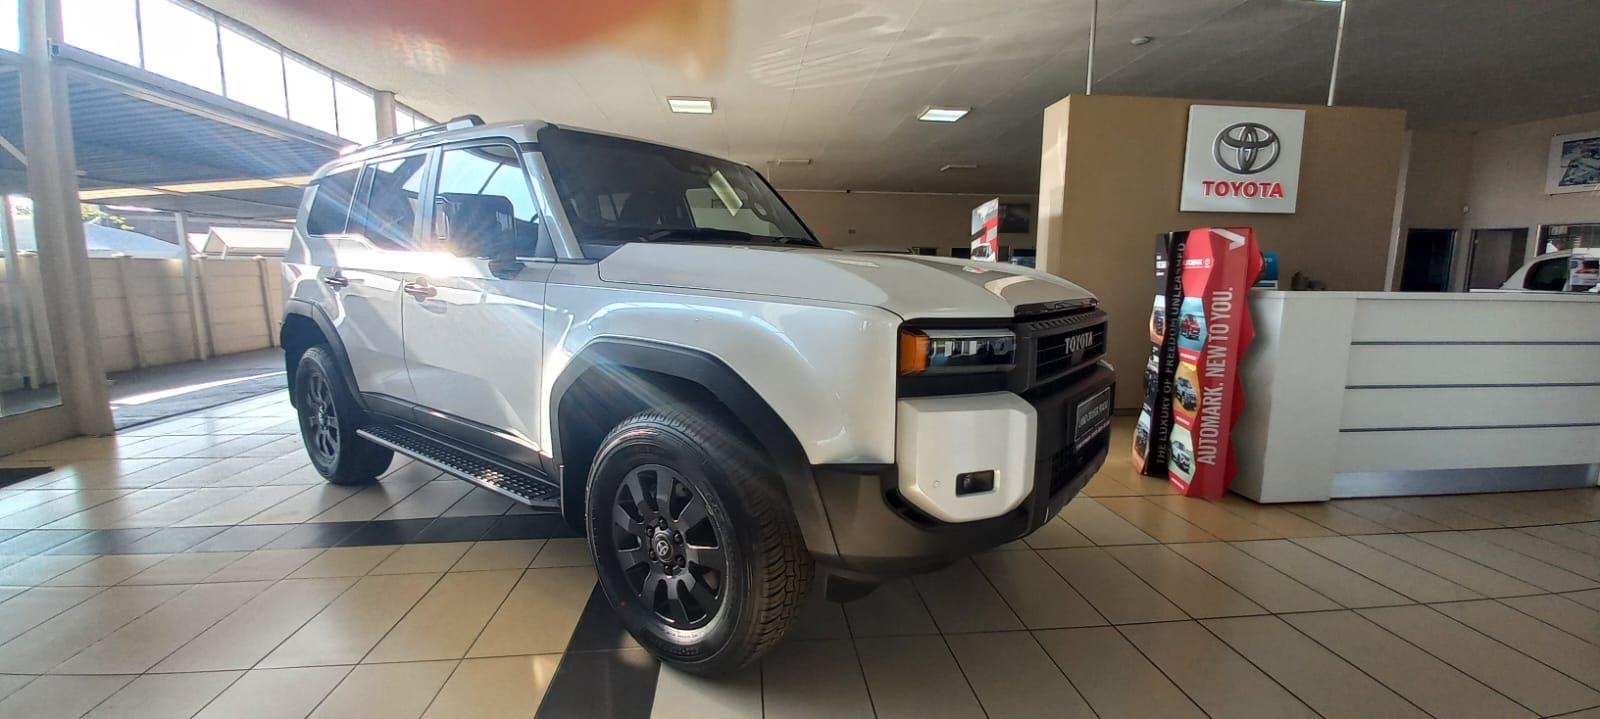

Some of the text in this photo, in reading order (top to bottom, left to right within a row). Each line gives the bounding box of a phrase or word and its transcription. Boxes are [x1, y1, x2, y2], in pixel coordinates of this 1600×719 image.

[1202, 180, 1284, 199] TOYOTA
[1065, 331, 1093, 354] TOYOTA
[1164, 318, 1178, 374] FREEDOM
[1162, 379, 1172, 393] OF
[1197, 286, 1234, 465] AUTOMARK. NEW TO YOU.
[1158, 396, 1170, 442] LUXURY
[1156, 443, 1167, 464] THE
